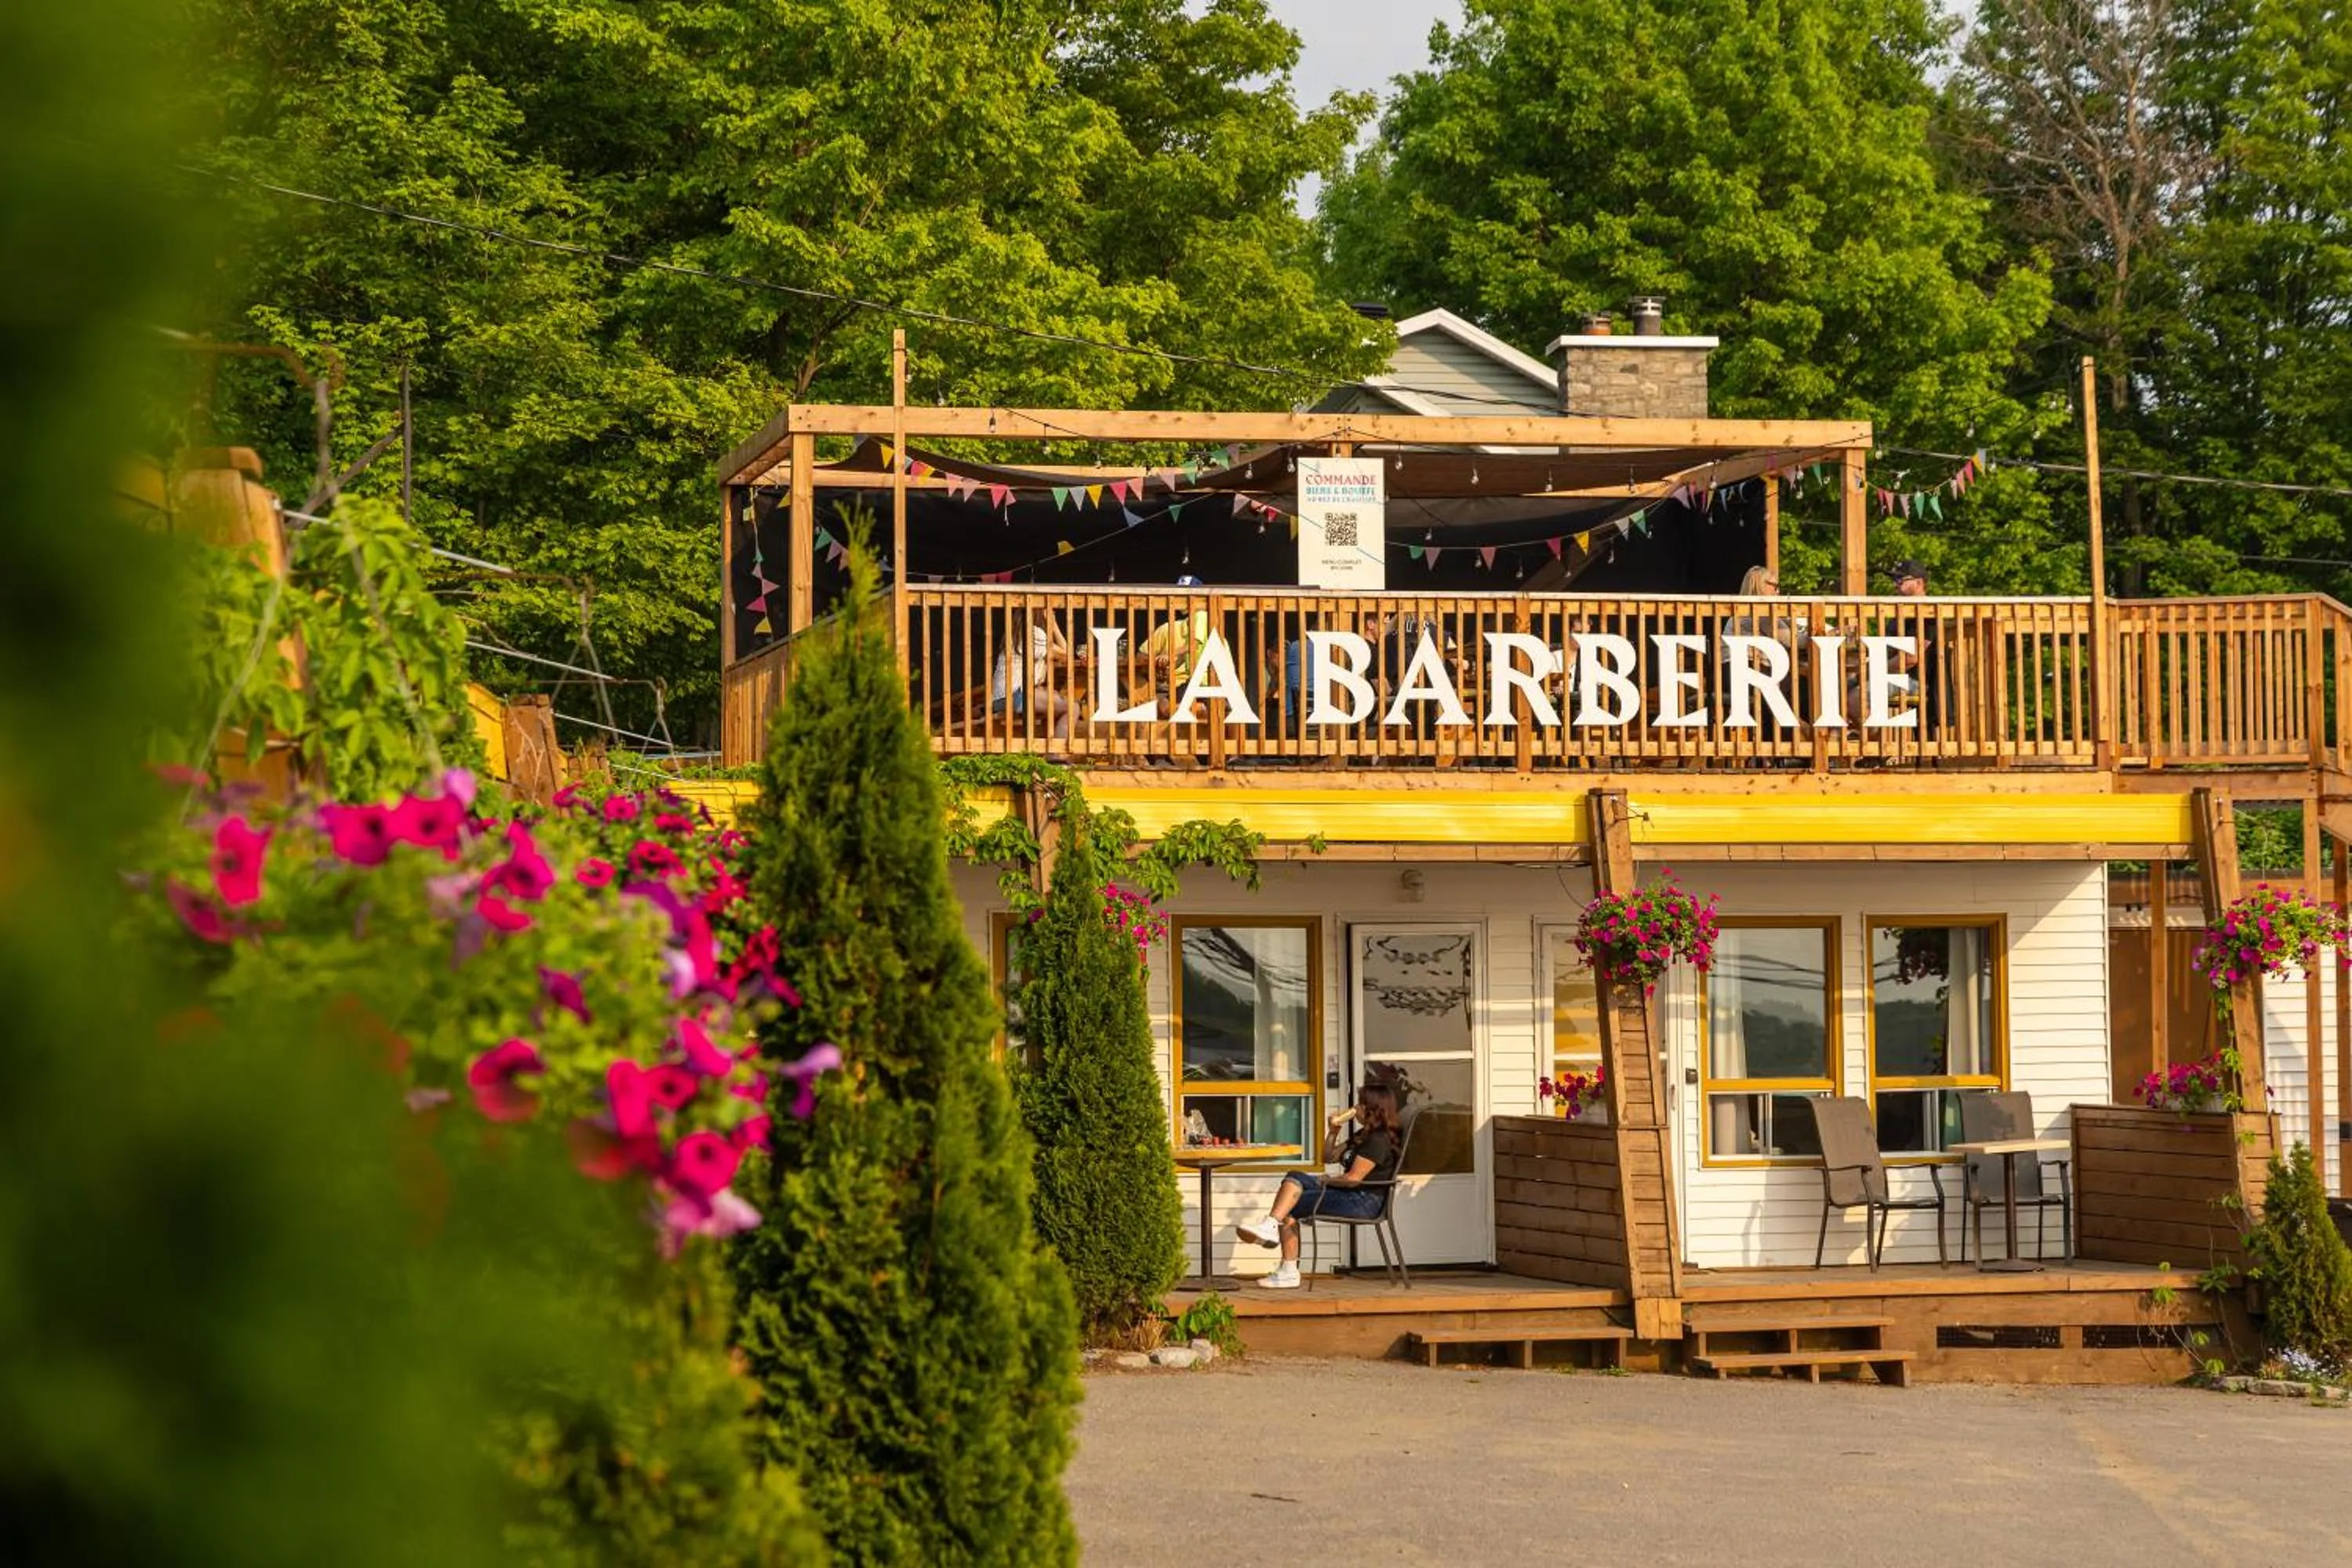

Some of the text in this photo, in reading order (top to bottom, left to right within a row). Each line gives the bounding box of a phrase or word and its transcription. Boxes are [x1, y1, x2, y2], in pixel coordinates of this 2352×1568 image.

[1305, 474, 1377, 485] COMMANDE
[1091, 627, 1918, 727] LA BARBERIE
